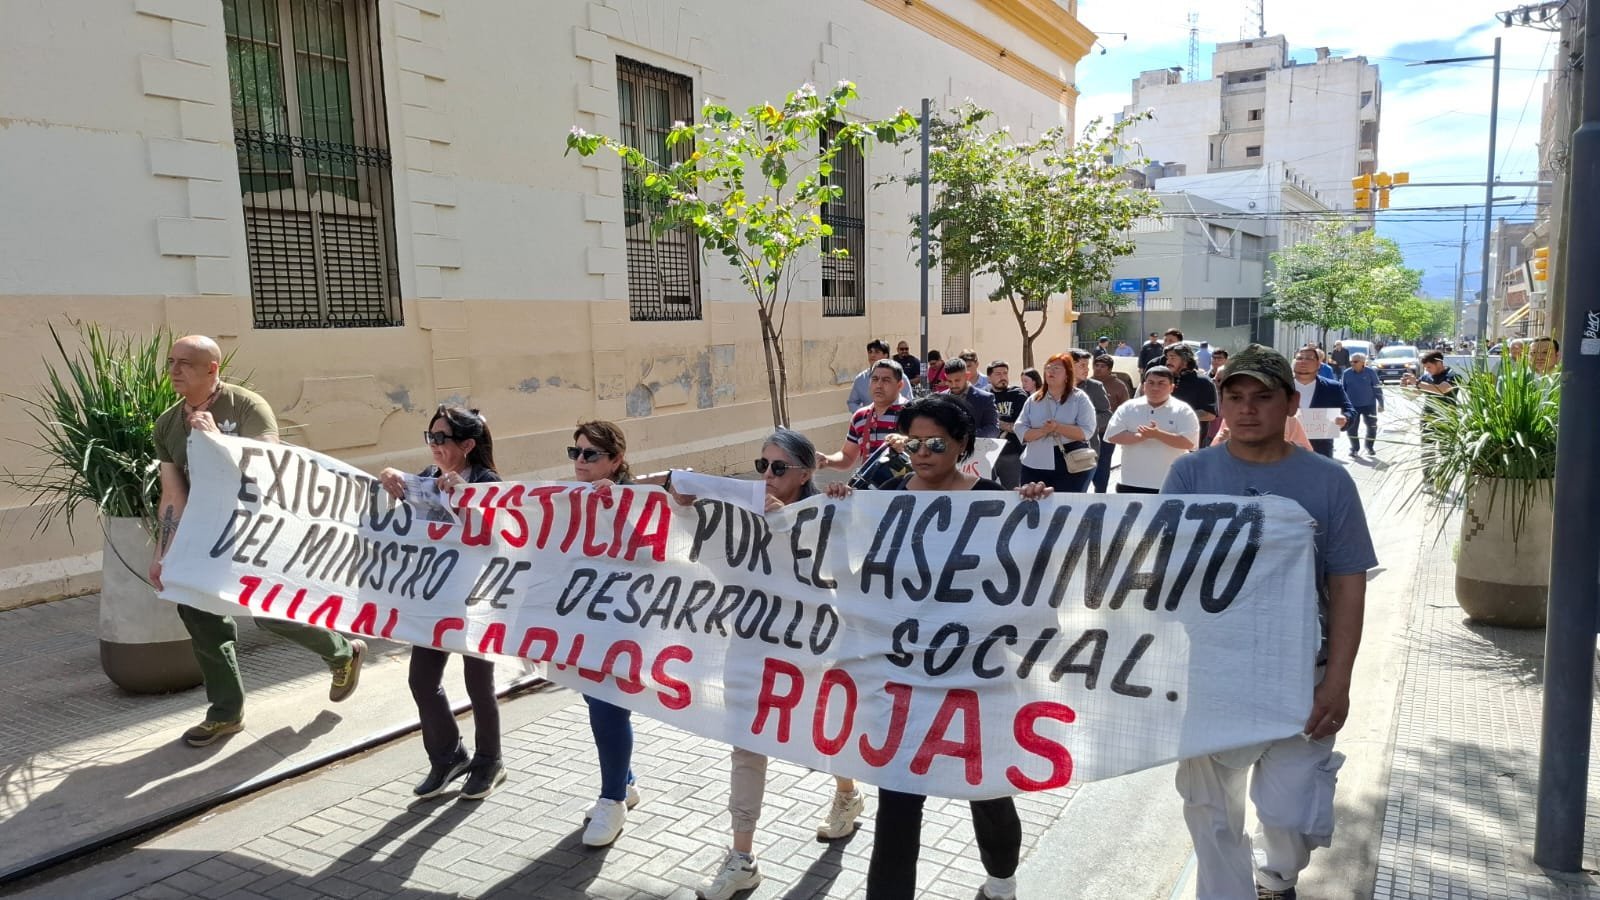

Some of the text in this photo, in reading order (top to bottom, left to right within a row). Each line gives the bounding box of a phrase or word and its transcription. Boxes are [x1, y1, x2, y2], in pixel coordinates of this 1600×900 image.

[210, 509, 1178, 702] DEL MINISTRO DE DESARROLLO SOCIAL.
[238, 447, 412, 536] EXIGIMOS
[689, 498, 773, 575] POR
[791, 503, 838, 589] EL
[860, 495, 1263, 614] ASESINATO
[751, 658, 1076, 791] ROJAS
